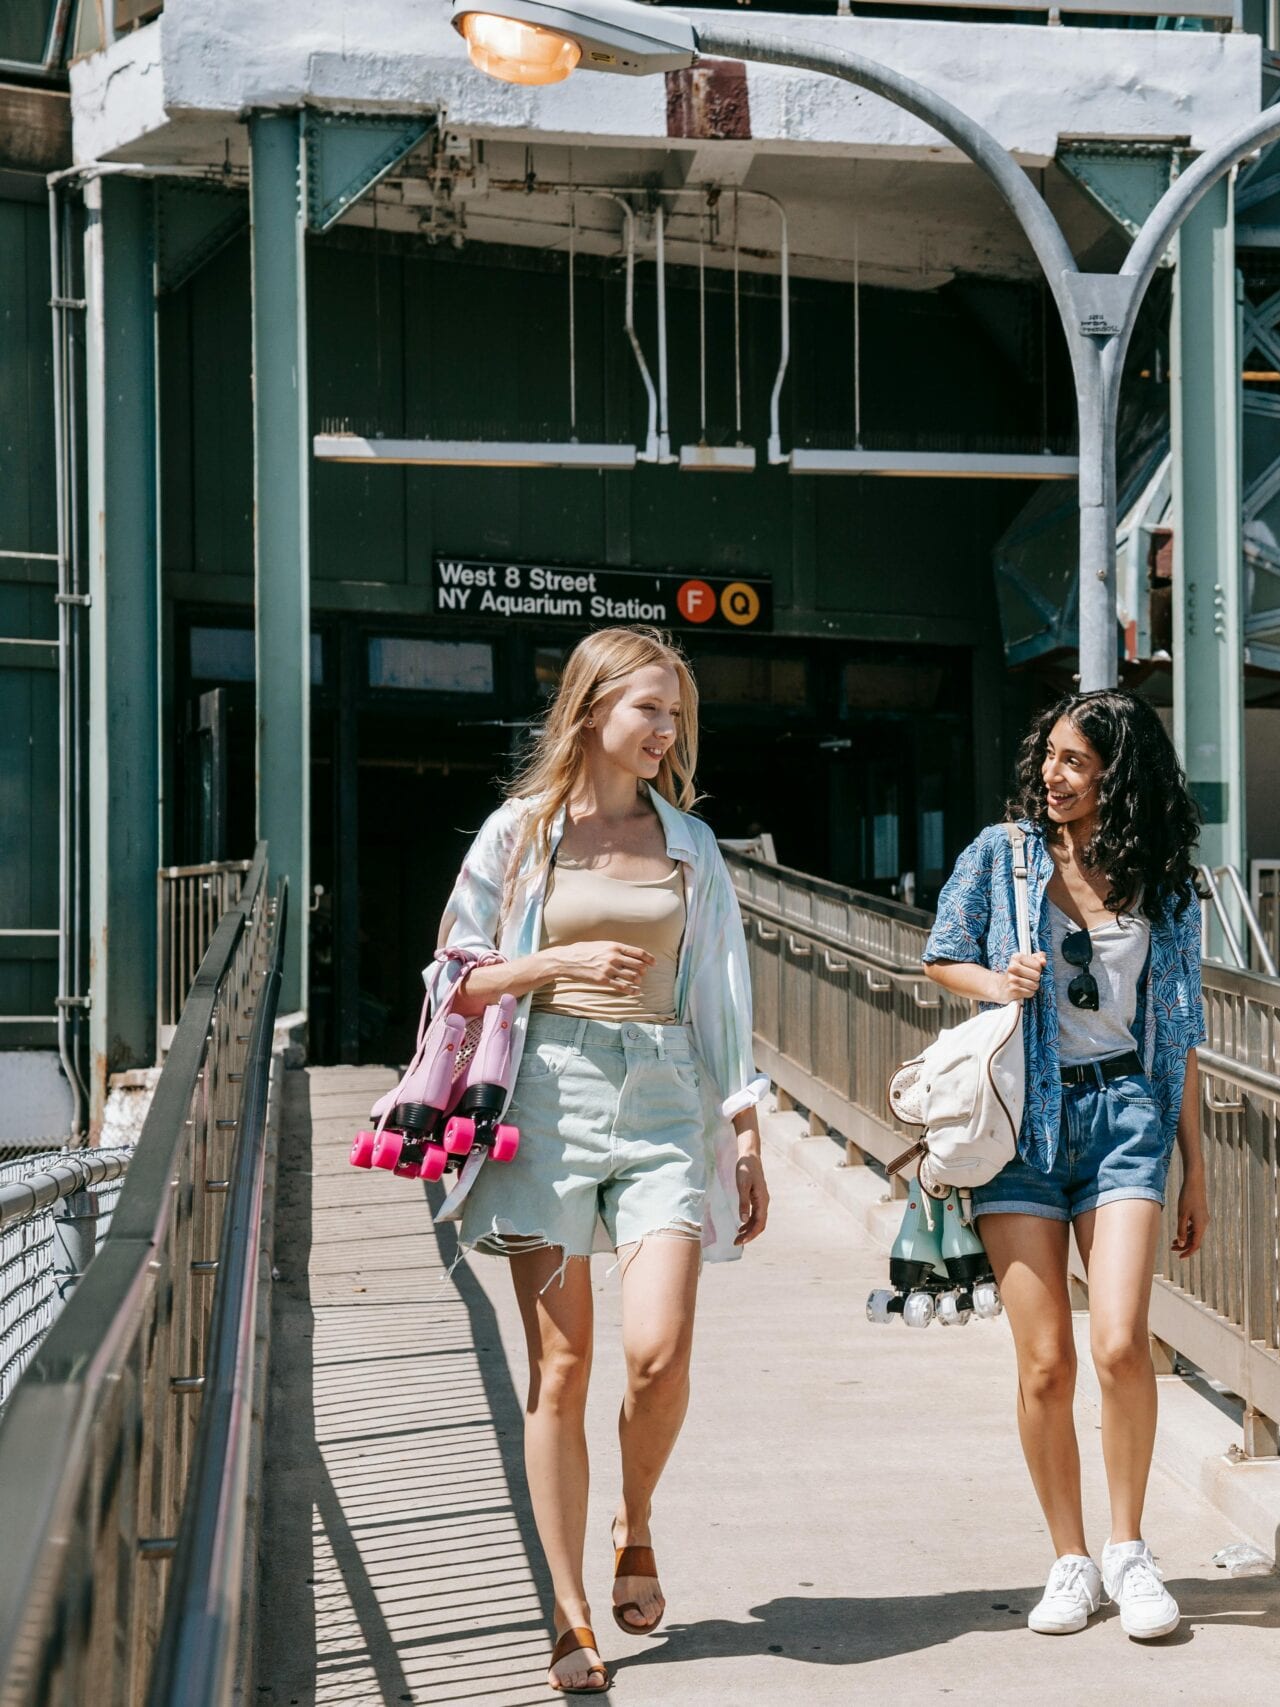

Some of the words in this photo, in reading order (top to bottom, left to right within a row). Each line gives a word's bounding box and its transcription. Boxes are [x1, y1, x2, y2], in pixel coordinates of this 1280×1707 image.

[438, 562, 497, 587] West
[504, 567, 521, 589] 8
[529, 568, 597, 593] Street
[438, 588, 471, 610] NY
[479, 589, 582, 617] Aquarium
[590, 595, 666, 620] Station
[687, 590, 703, 613] F
[730, 592, 750, 615] Q
